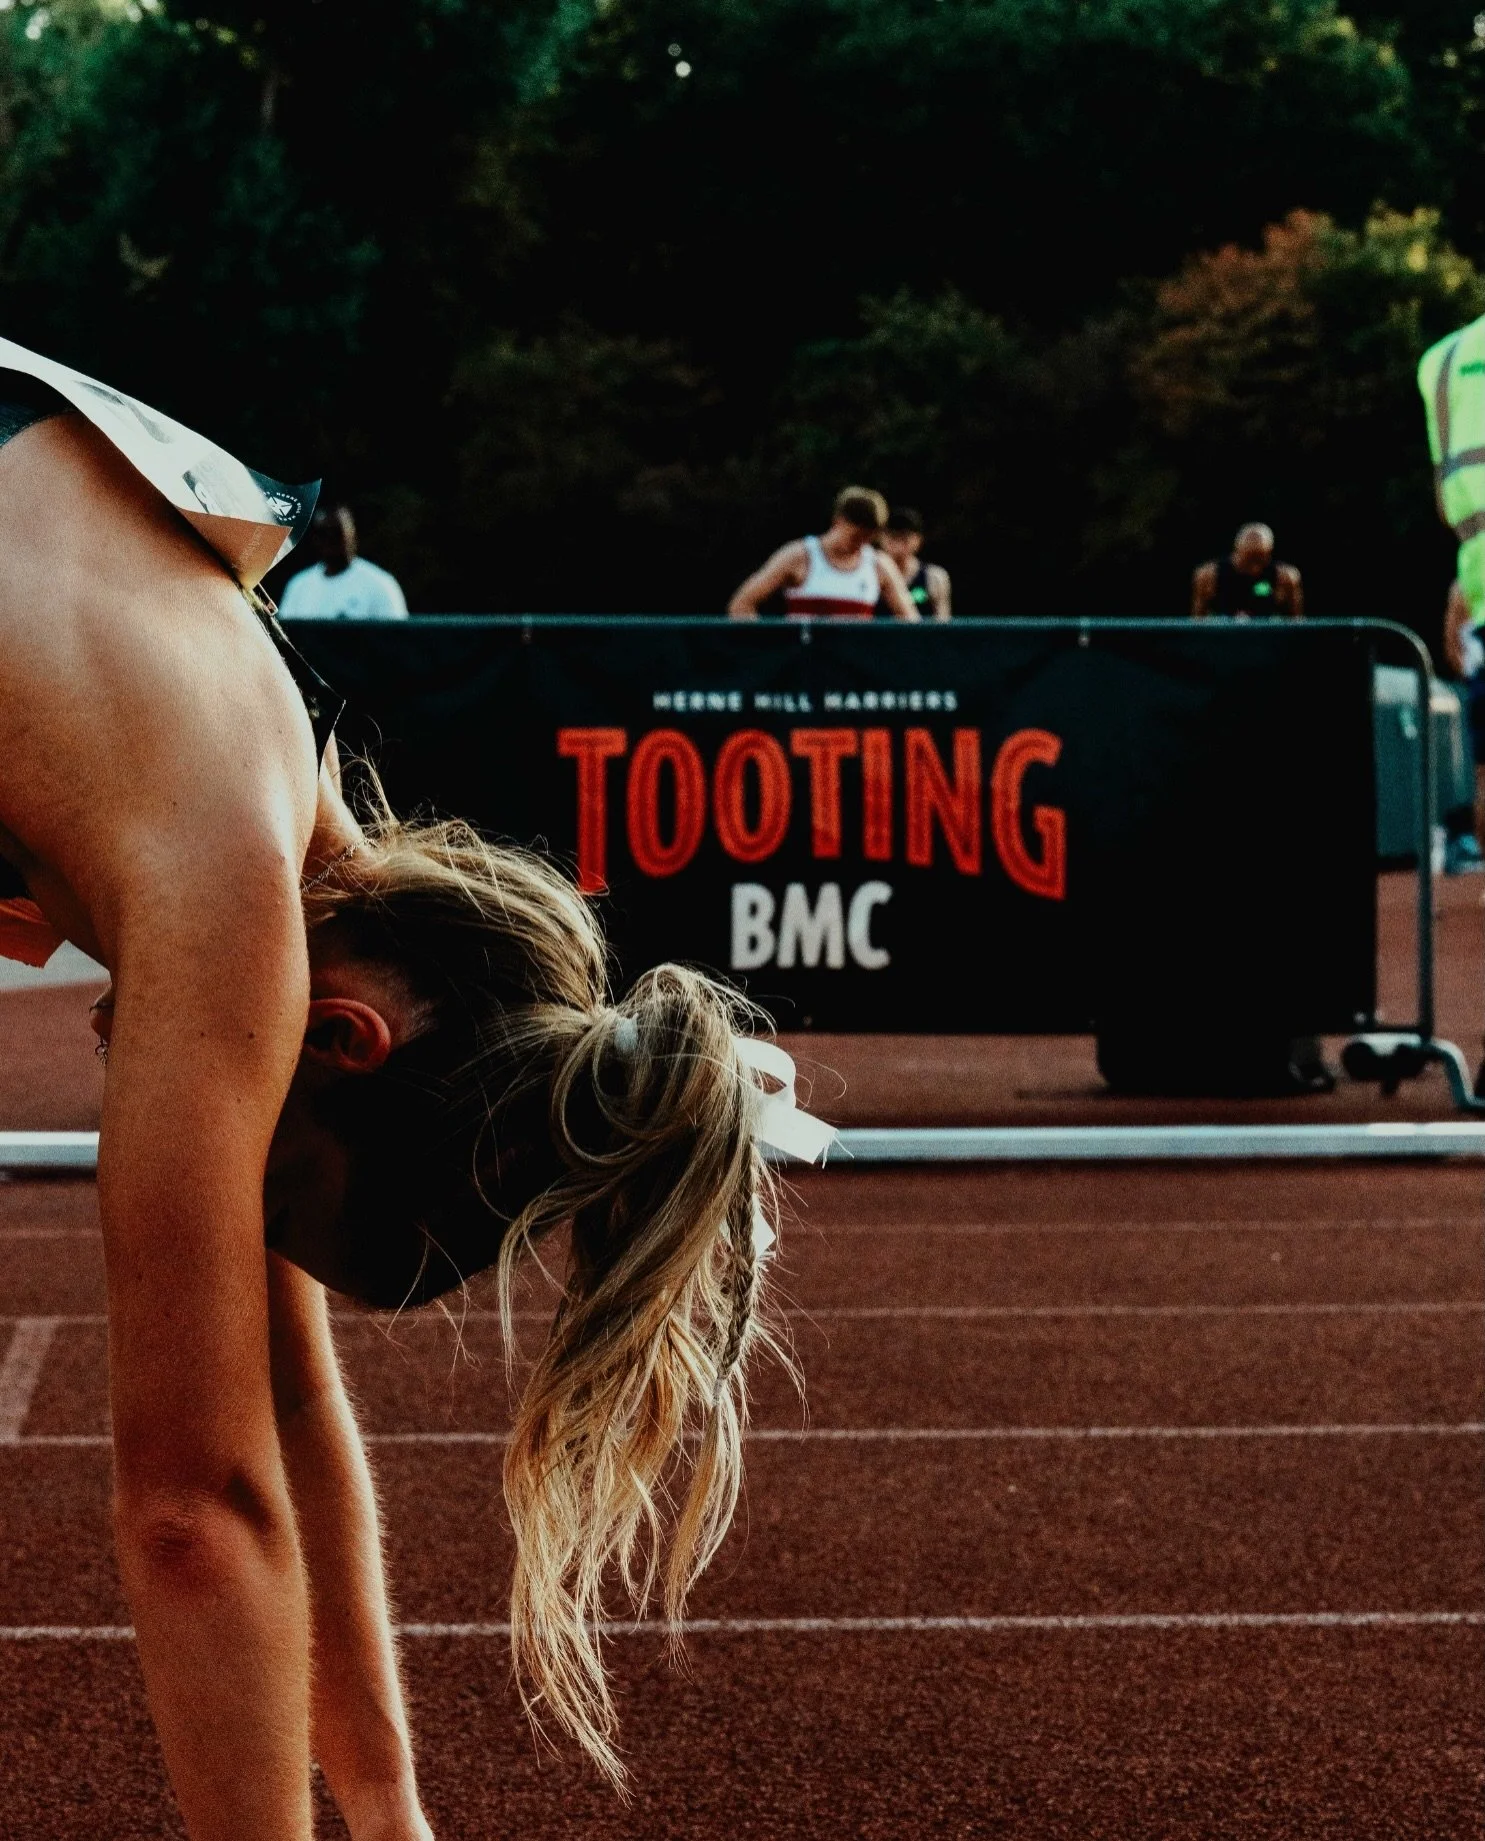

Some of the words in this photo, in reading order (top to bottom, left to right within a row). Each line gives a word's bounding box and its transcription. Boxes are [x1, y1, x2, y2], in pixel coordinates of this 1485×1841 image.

[653, 691, 743, 712] HERNE
[754, 691, 812, 712] HILL
[824, 691, 958, 712] HARRIERS
[556, 727, 1067, 899] TOOTING
[731, 881, 893, 970] BMC
